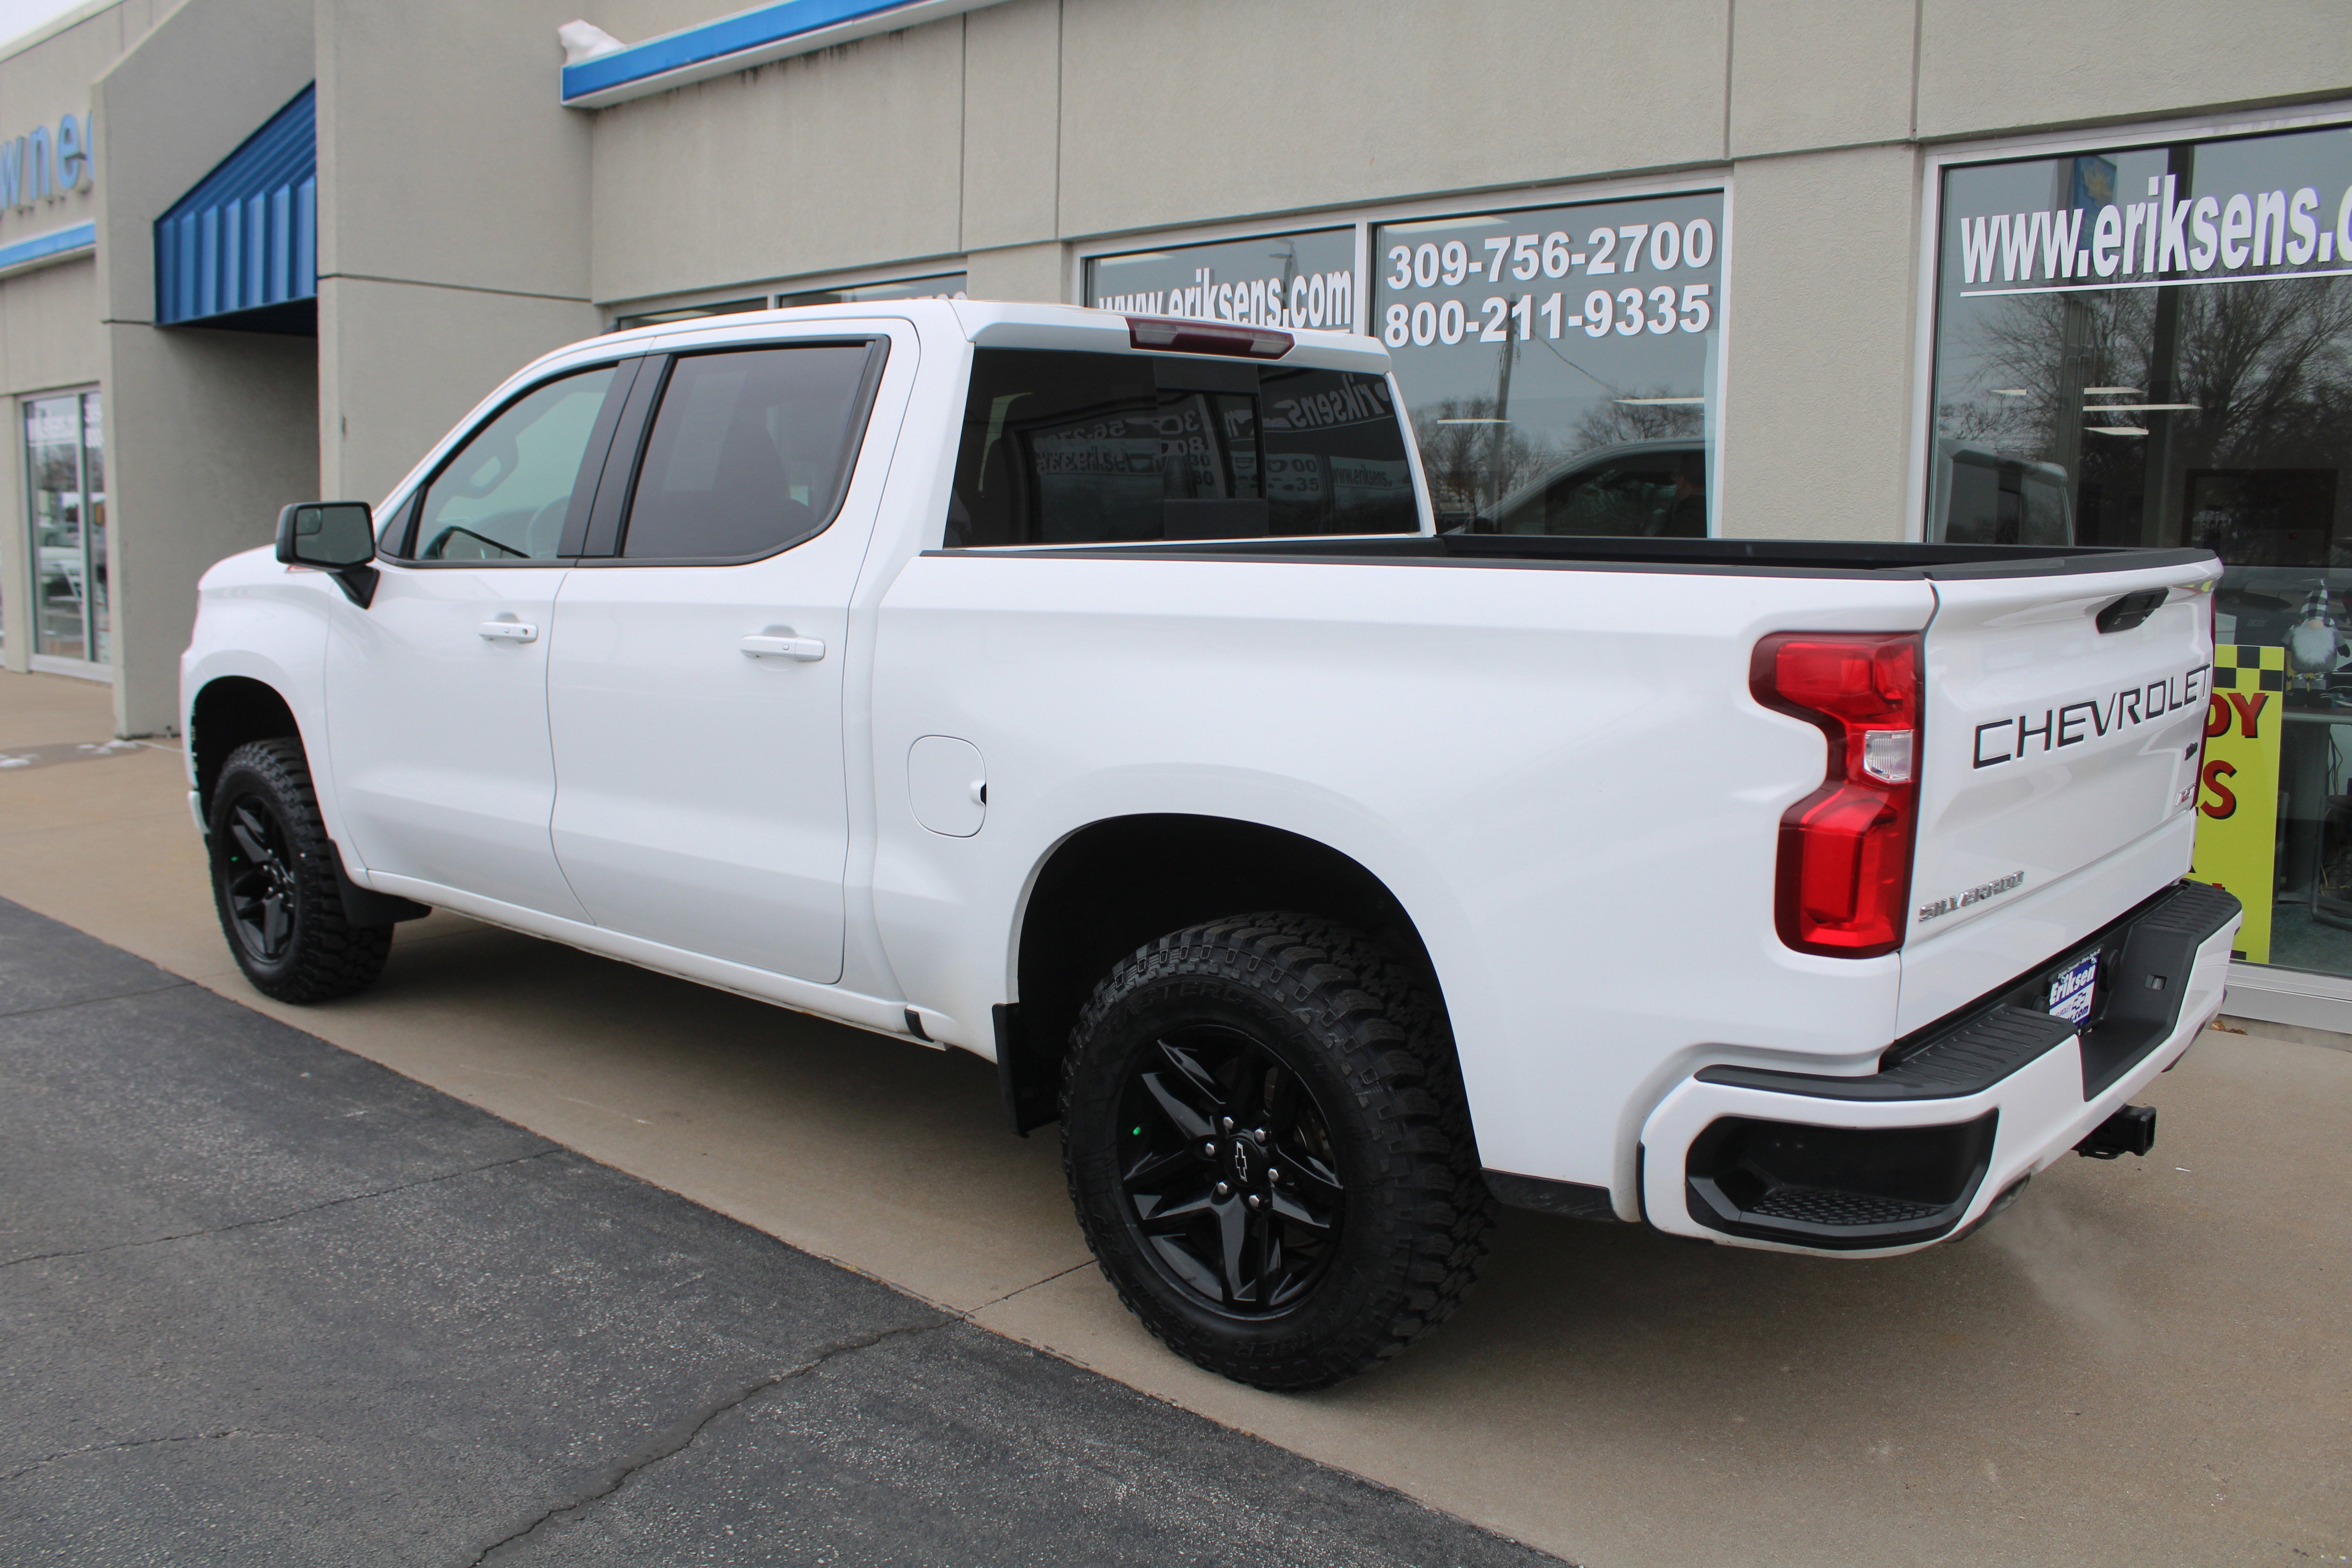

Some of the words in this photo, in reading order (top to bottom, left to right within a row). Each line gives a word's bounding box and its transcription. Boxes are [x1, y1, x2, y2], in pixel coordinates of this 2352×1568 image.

[0, 109, 94, 210] wne
[1387, 218, 1714, 290] 309-756-2700
[1099, 267, 1352, 328] eriksens.com
[1385, 283, 1711, 348] 800-211-9335
[1973, 663, 2211, 769] CHEVROLET
[1918, 870, 2024, 922] SILVERADO
[2049, 964, 2096, 1006] Eriksen
